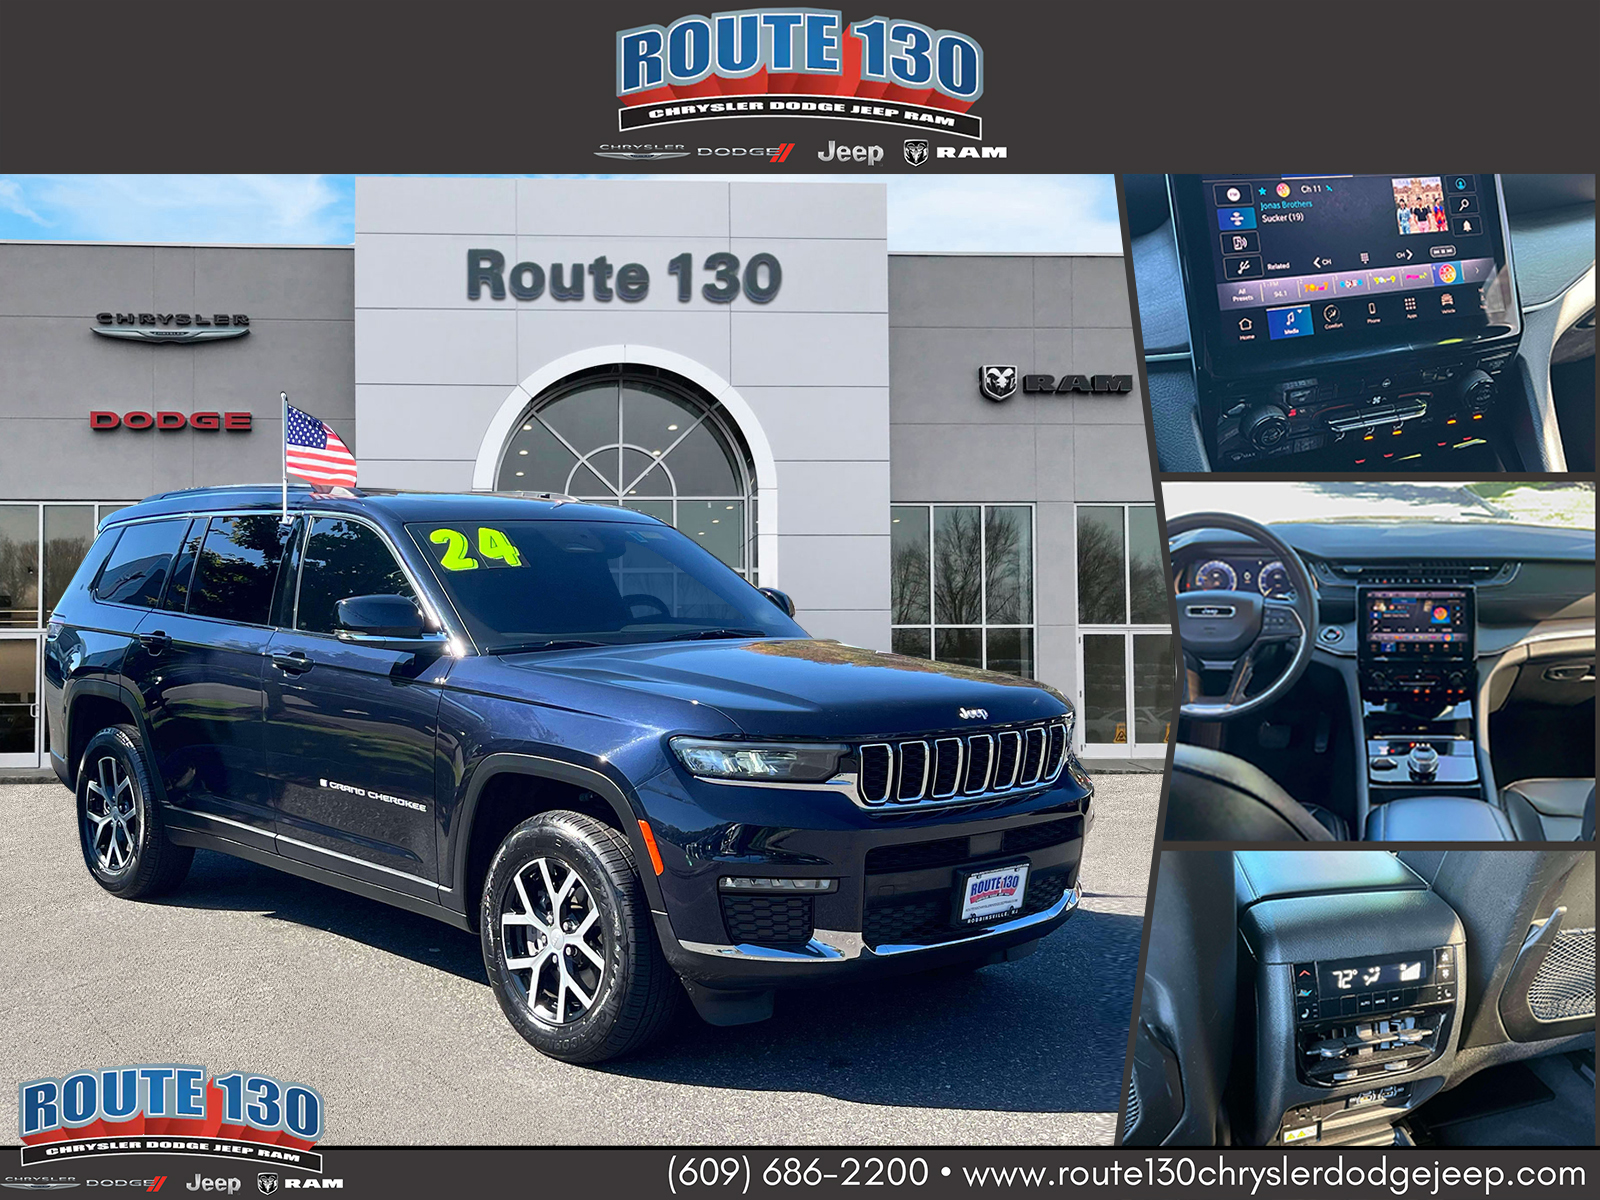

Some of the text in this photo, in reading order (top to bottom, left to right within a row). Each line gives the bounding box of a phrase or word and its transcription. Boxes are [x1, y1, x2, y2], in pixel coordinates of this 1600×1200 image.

[1260, 200, 1313, 211] Jonas Brothers
[1261, 213, 1287, 223] Sucker
[466, 248, 783, 304] Route 130
[1267, 261, 1291, 271] Related
[96, 312, 250, 325] CHRYSLER
[1023, 374, 1134, 394] RAM
[90, 410, 252, 431] DODGE
[429, 527, 522, 571] 24
[959, 707, 989, 720] Jeep
[328, 781, 427, 812] GRAND CHEROKEE
[970, 875, 1019, 897] ROUTE 130
